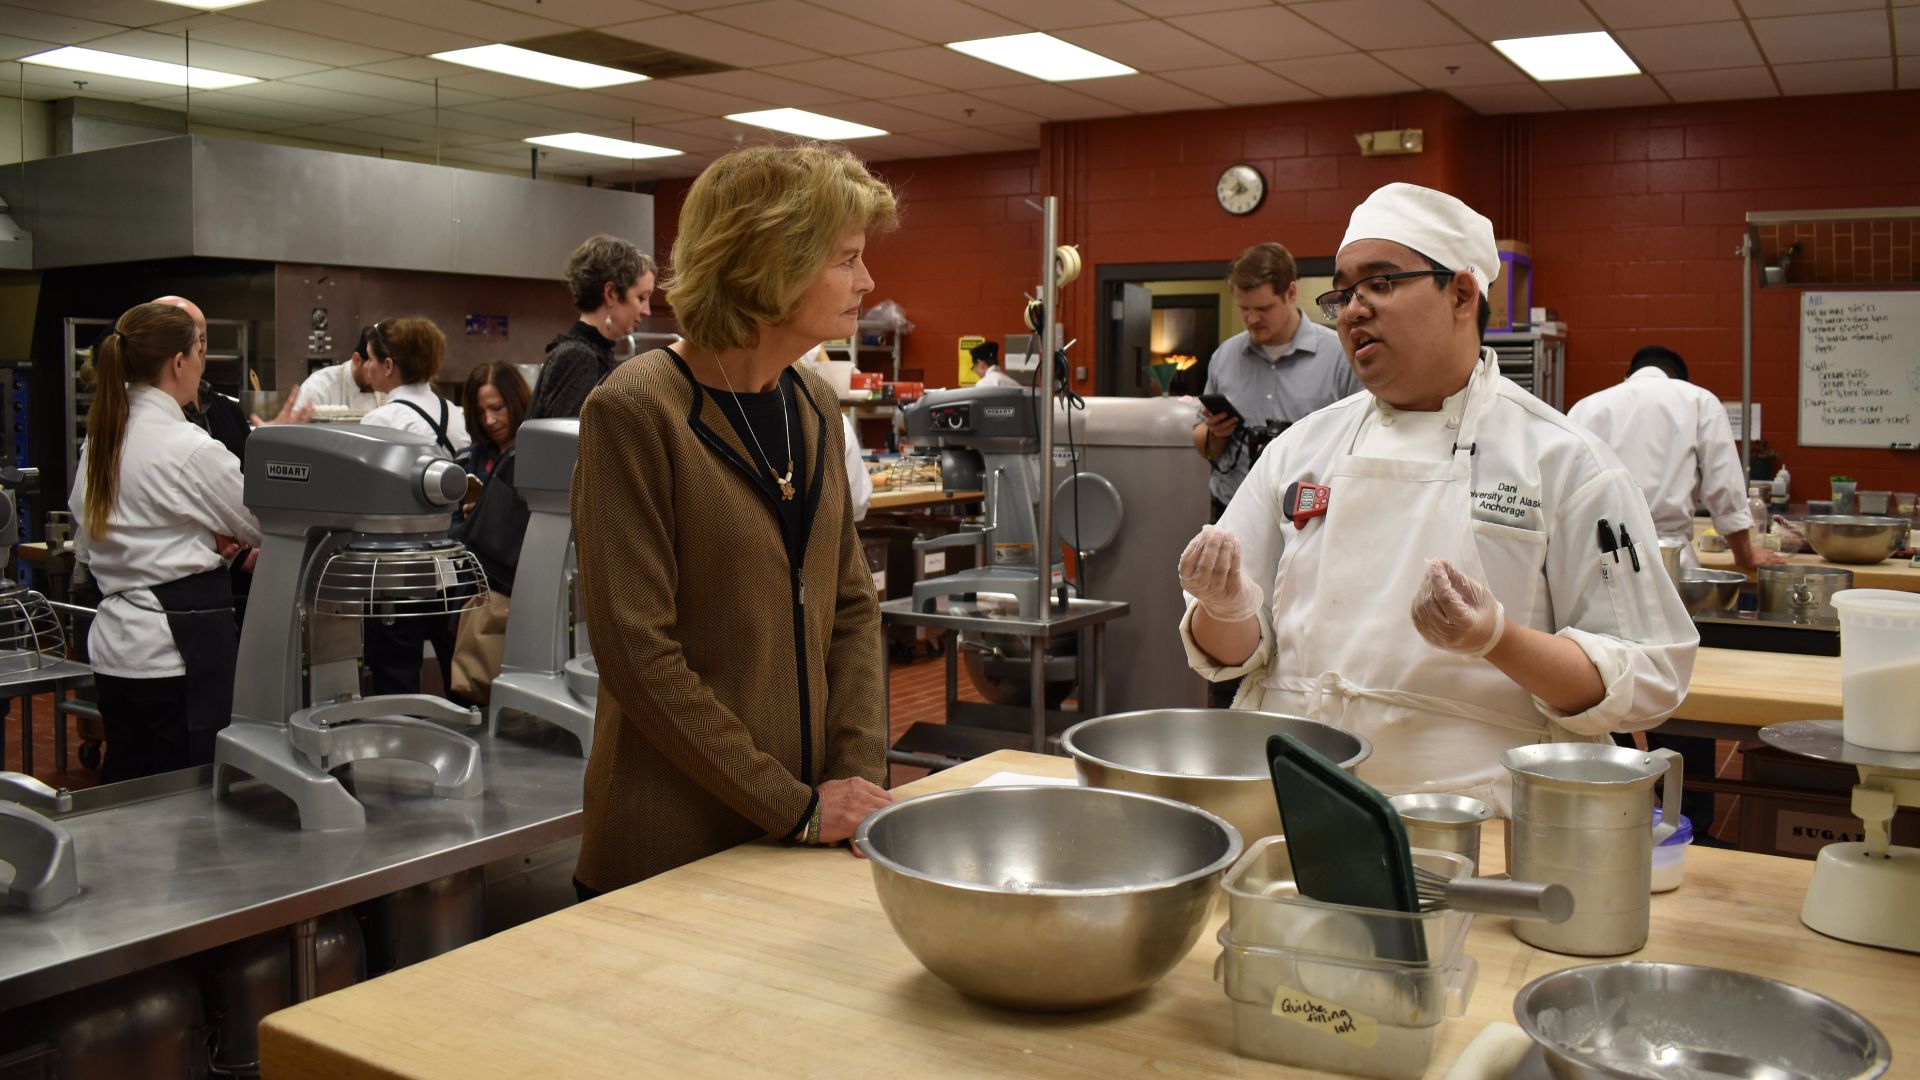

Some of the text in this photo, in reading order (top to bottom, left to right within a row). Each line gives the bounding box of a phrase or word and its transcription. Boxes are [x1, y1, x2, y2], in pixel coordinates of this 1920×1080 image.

[269, 465, 308, 476] HOBART
[1497, 482, 1518, 494] Dani
[1506, 495, 1516, 504] of
[1519, 496, 1542, 508] Alask
[1478, 500, 1526, 518] Anchorage
[1281, 998, 1325, 1013] Quiche
[1306, 1008, 1353, 1024] filling
